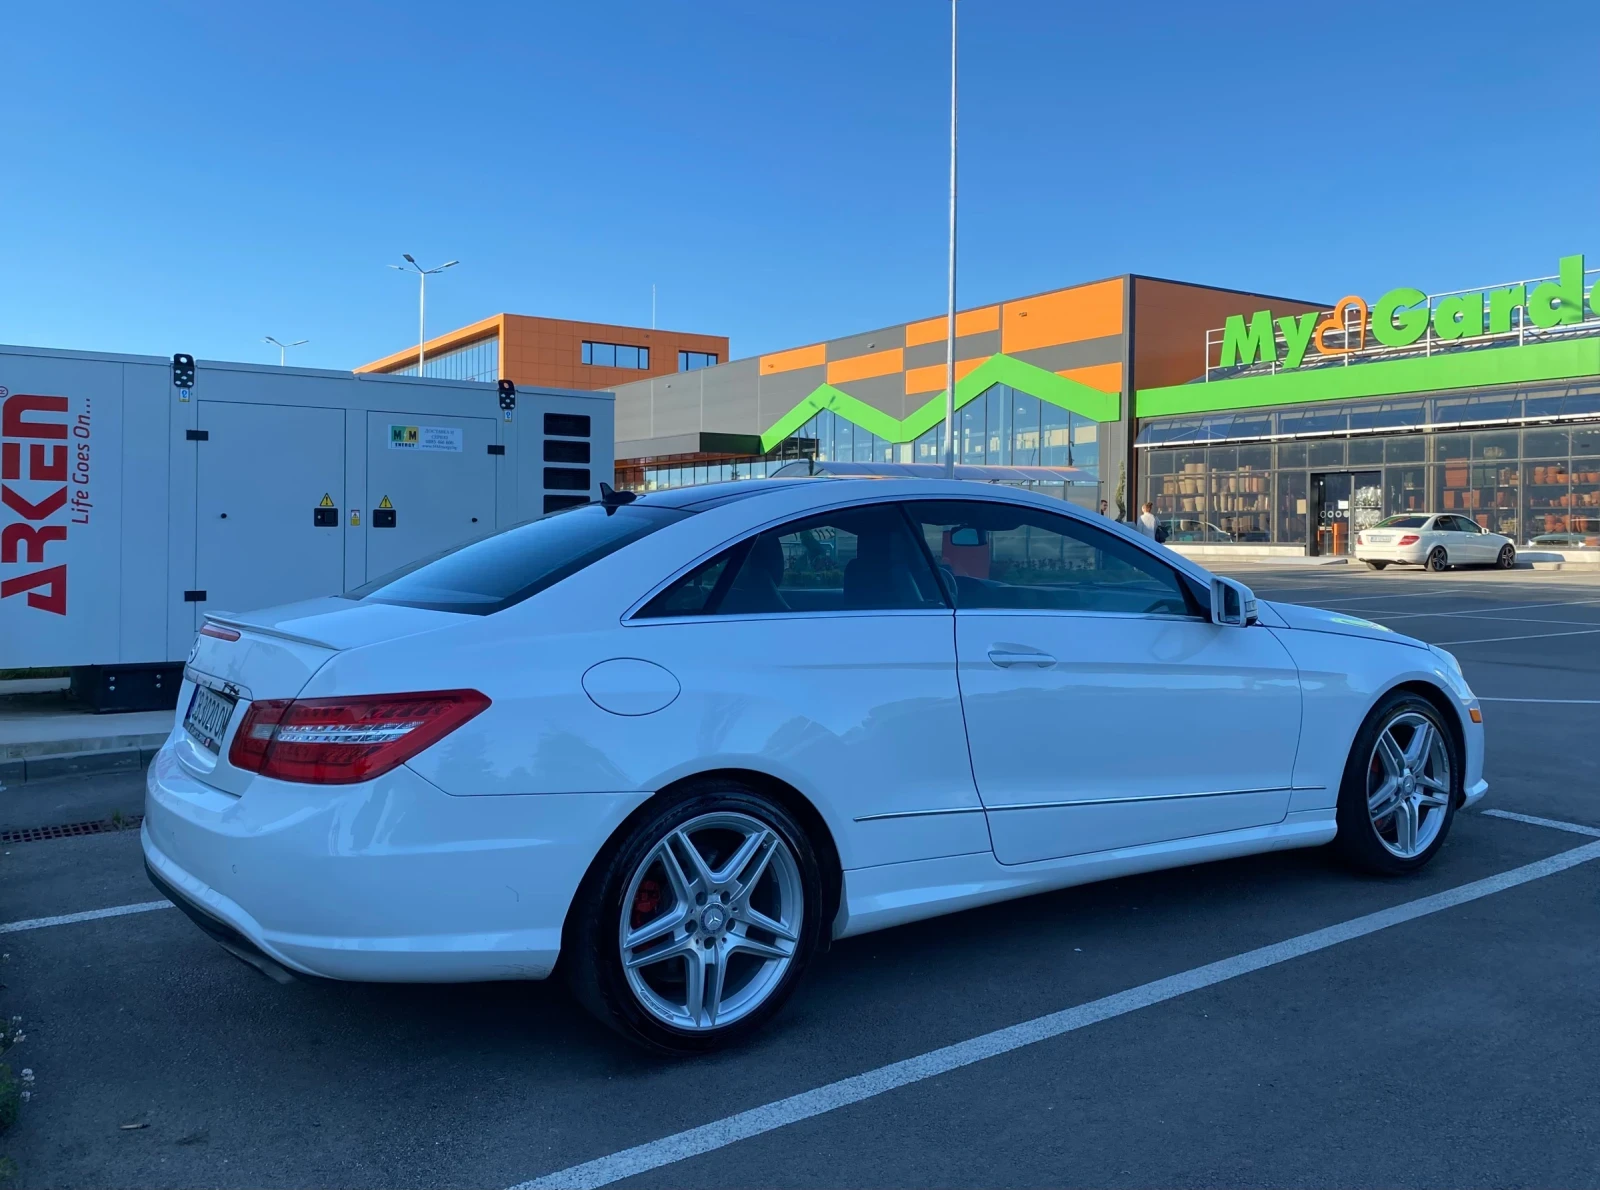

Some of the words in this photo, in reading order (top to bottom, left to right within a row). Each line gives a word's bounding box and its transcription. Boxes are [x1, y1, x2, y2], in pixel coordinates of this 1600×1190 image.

[1219, 309, 1320, 369] My
[1371, 255, 1600, 348] Gard
[72, 443, 90, 485] Goes
[1, 394, 68, 616] ARKEN
[72, 490, 93, 524] Life
